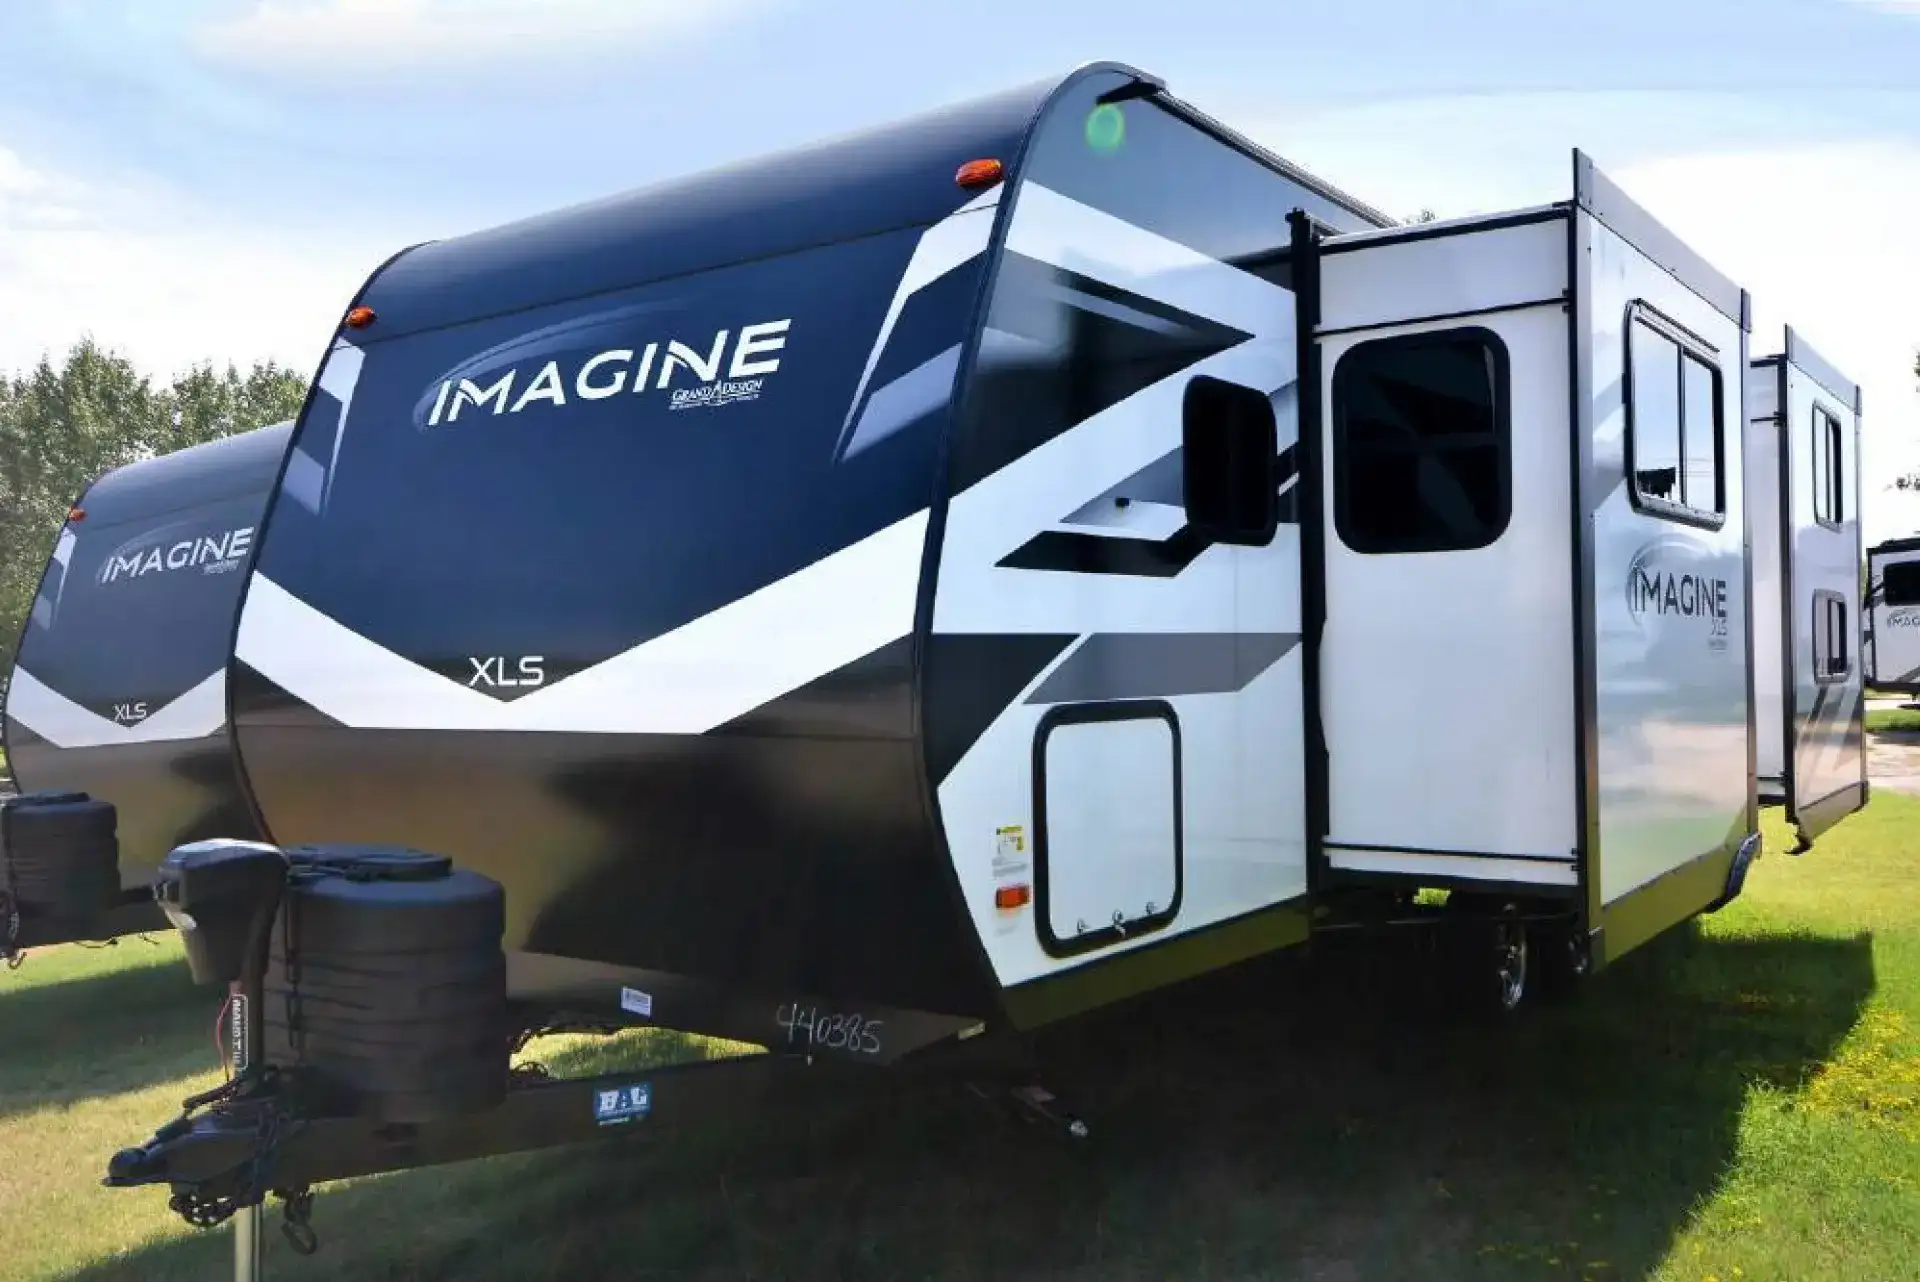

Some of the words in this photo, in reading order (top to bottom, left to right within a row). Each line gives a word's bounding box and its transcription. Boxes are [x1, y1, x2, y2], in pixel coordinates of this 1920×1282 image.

[428, 318, 792, 427] IMAGINE
[101, 526, 255, 584] IMAGINE
[1633, 566, 1727, 618] IMAGINE
[467, 655, 545, 686] XLS
[112, 701, 149, 722] XLS
